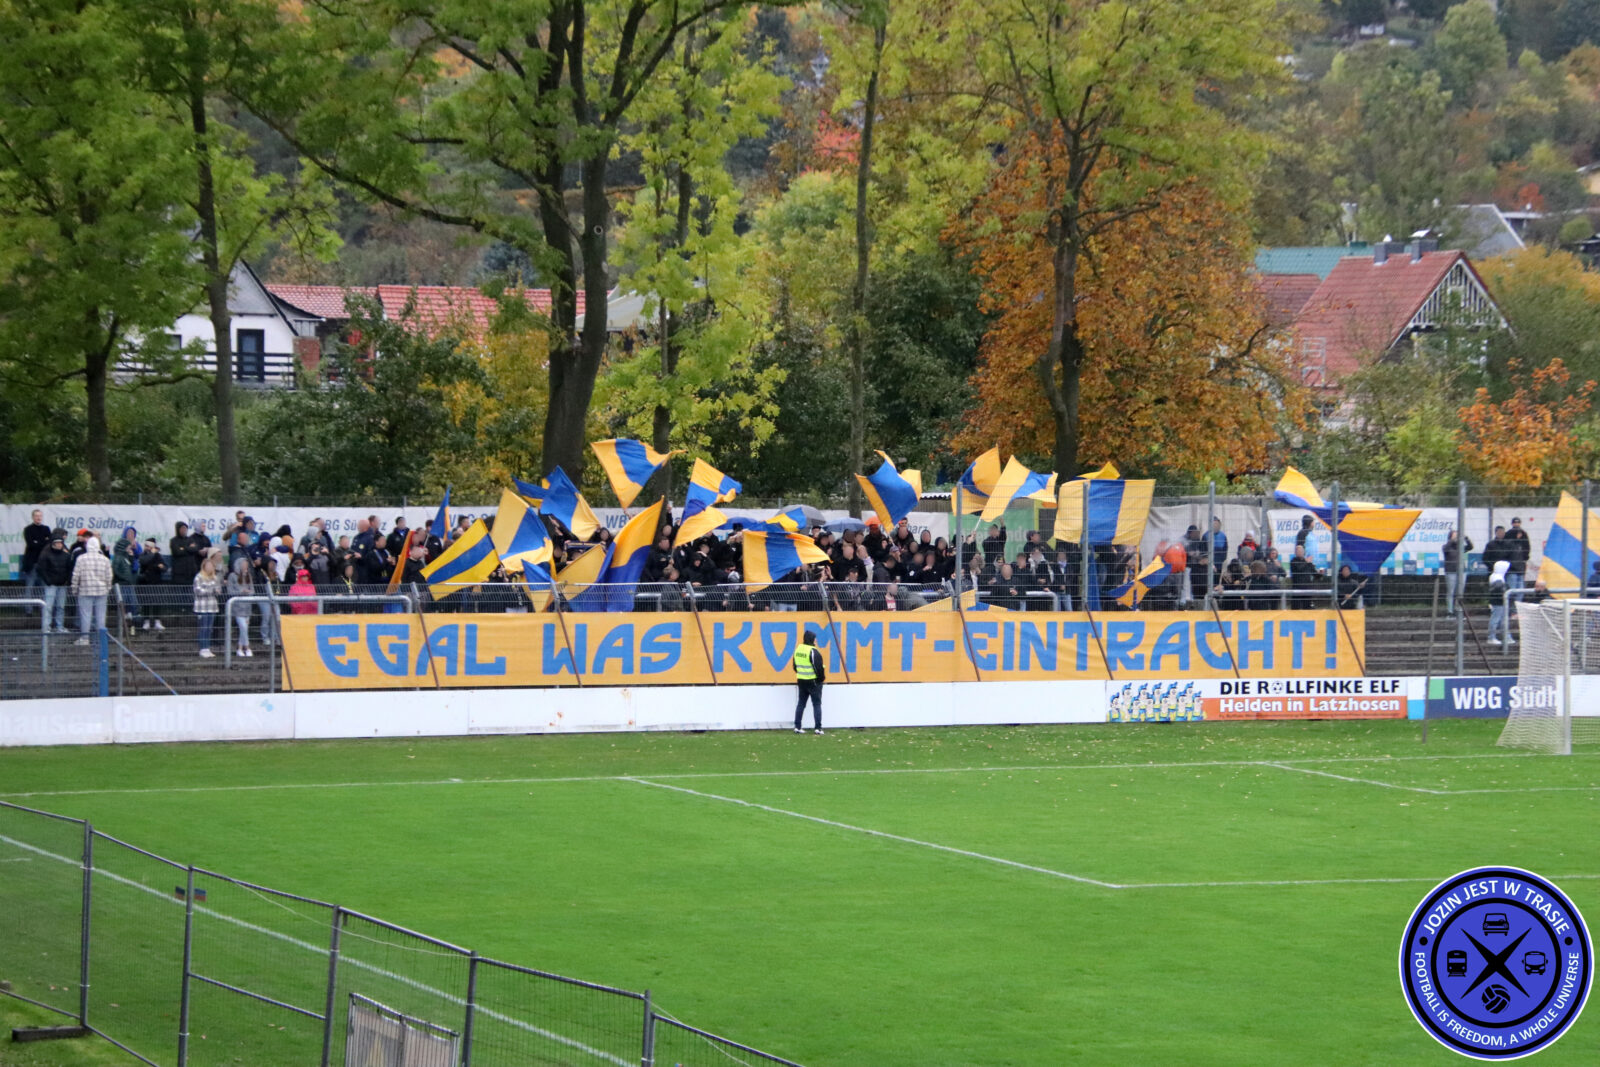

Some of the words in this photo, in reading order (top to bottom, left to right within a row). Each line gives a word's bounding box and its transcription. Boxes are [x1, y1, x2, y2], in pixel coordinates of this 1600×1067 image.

[55, 517, 84, 529] WBG
[88, 516, 136, 530] Südharz
[315, 623, 507, 678] EGAL
[541, 622, 682, 676] WAS
[1220, 681, 1251, 695] DIE
[1370, 679, 1400, 694] ELF
[1219, 698, 1282, 713] Helden
[1287, 697, 1304, 712] in
[1309, 697, 1401, 712] Latzhosen
[1452, 686, 1502, 710] WBG
